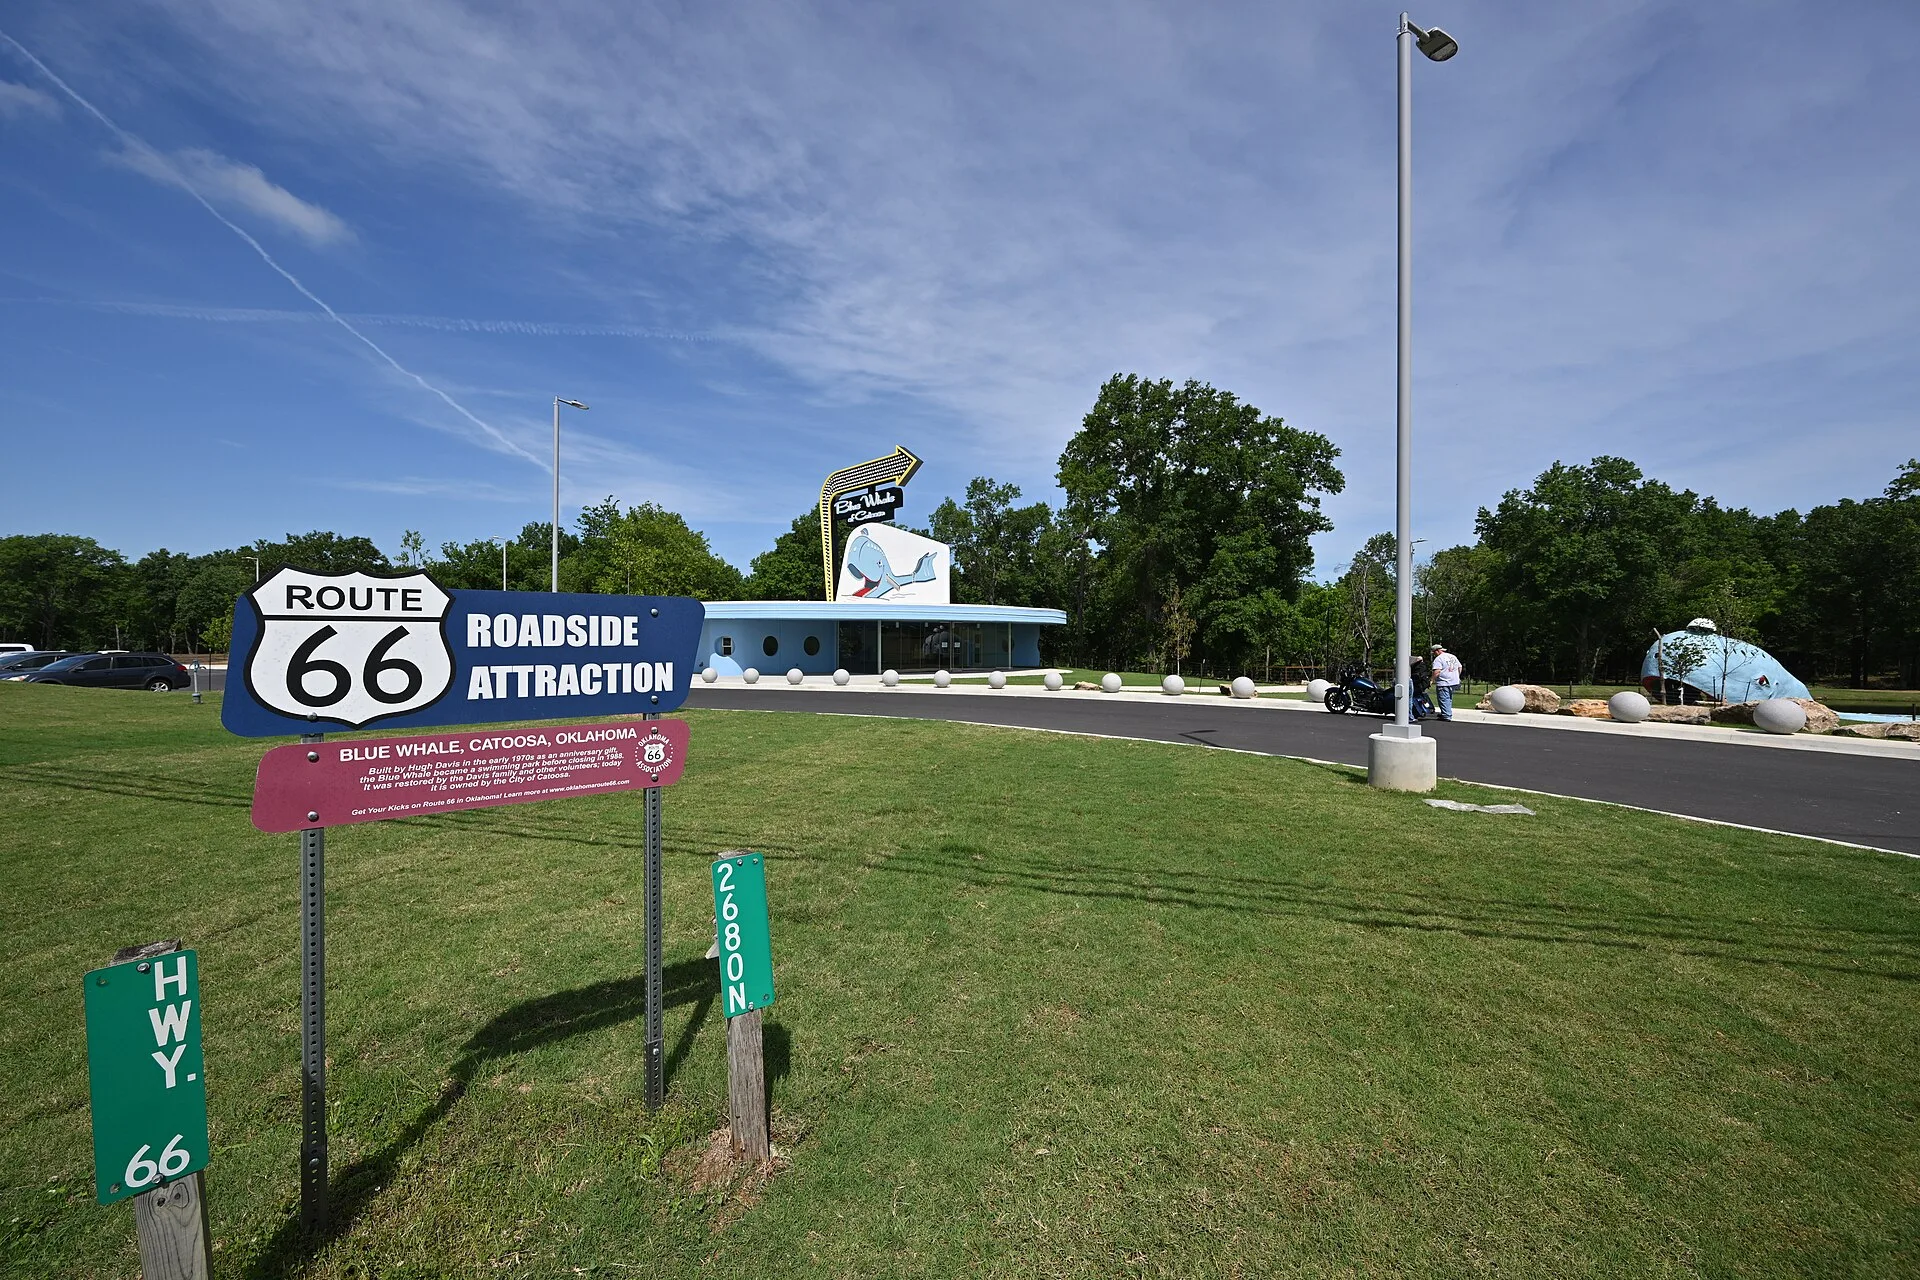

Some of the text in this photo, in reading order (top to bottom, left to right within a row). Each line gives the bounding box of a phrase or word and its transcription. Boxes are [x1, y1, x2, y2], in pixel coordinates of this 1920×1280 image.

[285, 584, 423, 612] ROUTE
[467, 614, 639, 648] ROADSIDE
[285, 624, 423, 708] 66
[467, 662, 674, 700] ATTRACTION
[340, 728, 638, 762] BLUE WHALE, CATOOSA, OKLAHOMA
[638, 734, 670, 746] OKLAHOMA
[368, 766, 392, 775] Built
[408, 763, 433, 772] Hugh
[436, 761, 460, 769] Davis
[489, 756, 509, 765] early
[512, 754, 534, 762] 1970s
[560, 749, 603, 758] anniversary
[402, 771, 431, 779] Whale
[434, 767, 468, 776] became
[478, 762, 520, 772] swimming
[522, 761, 540, 770] park
[568, 756, 595, 764] closing
[636, 758, 672, 773] ASSOCIATION
[648, 750, 661, 760] 66
[395, 778, 433, 787] restored
[466, 772, 490, 780] Davis
[492, 770, 516, 778] family
[558, 763, 600, 771] volunteers;
[450, 780, 479, 789] owned
[481, 779, 491, 787] by
[509, 775, 525, 784] City
[538, 772, 571, 780] Catoosa.
[466, 793, 503, 802] Oklahoma!
[549, 779, 630, 792] www.oklahomaroute66.com
[717, 862, 746, 1014] 2680N
[148, 956, 196, 1089] HWY.
[124, 1134, 190, 1188] 66
